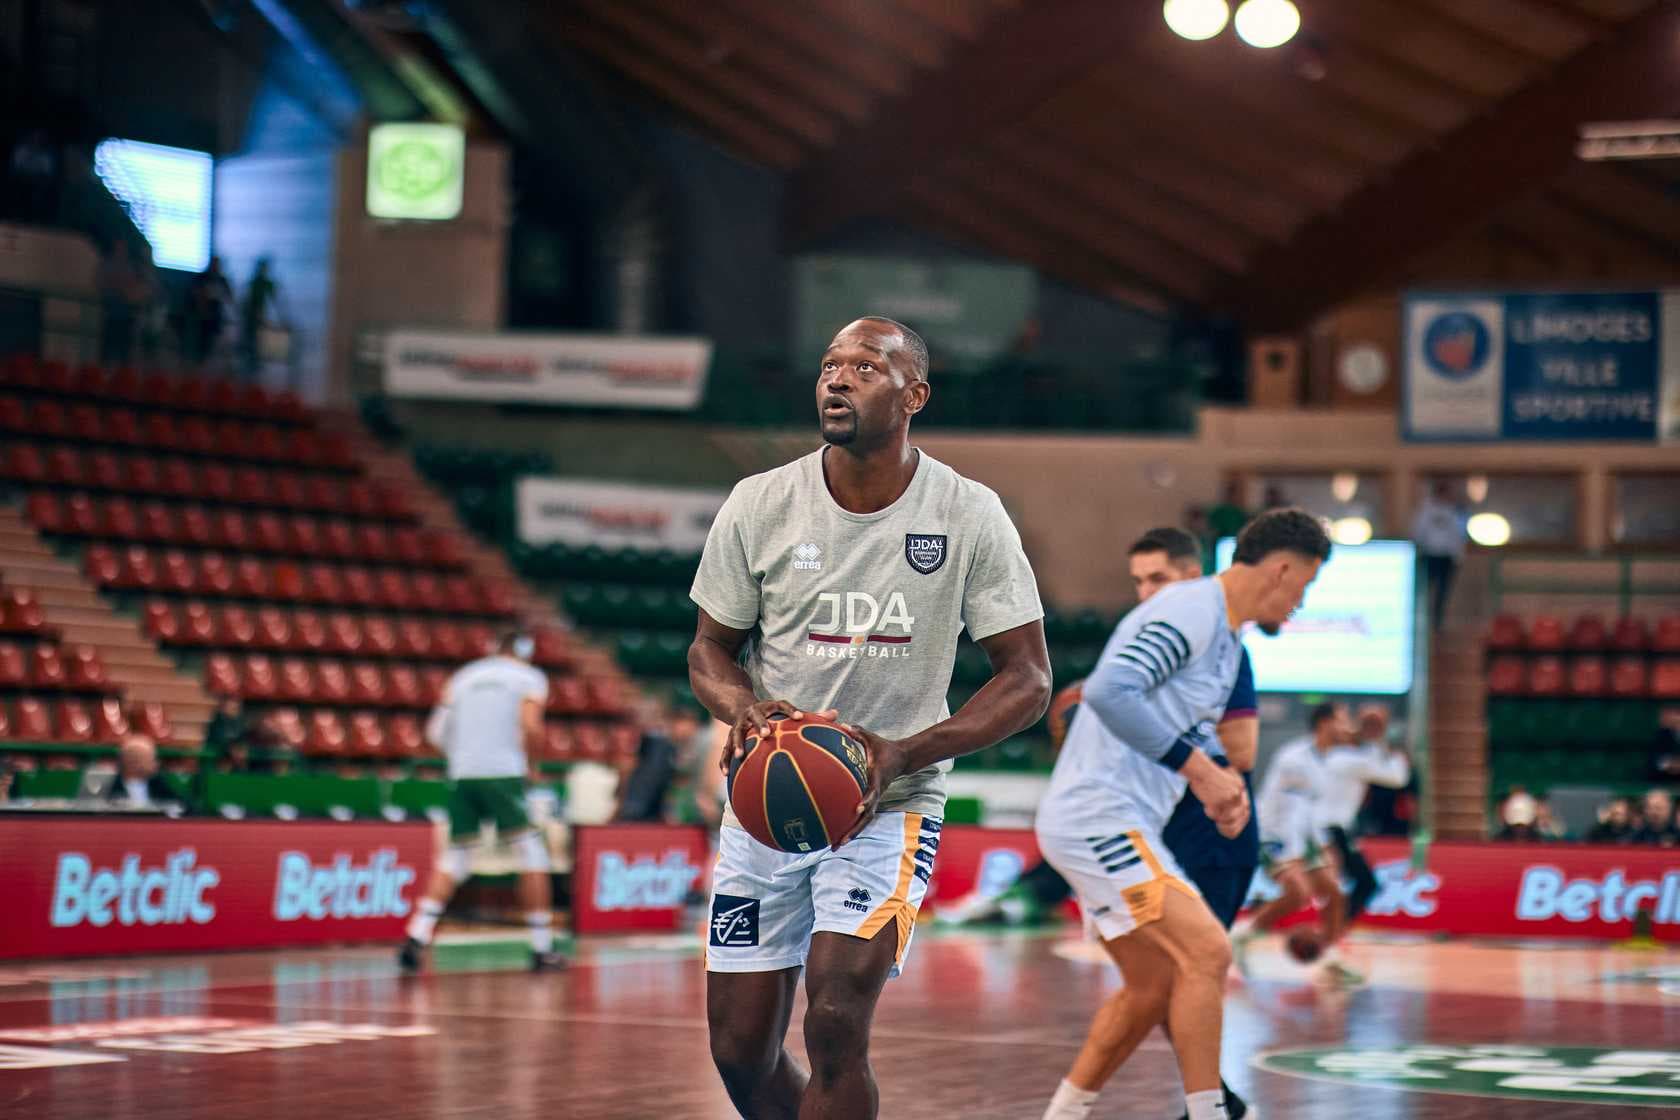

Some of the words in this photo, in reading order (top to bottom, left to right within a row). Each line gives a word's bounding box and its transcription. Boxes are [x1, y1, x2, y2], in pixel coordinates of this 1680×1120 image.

[808, 591, 915, 634] JDA
[806, 644, 910, 659] BASKETBALL
[50, 849, 220, 927] Betclic
[273, 849, 416, 921] Betclic
